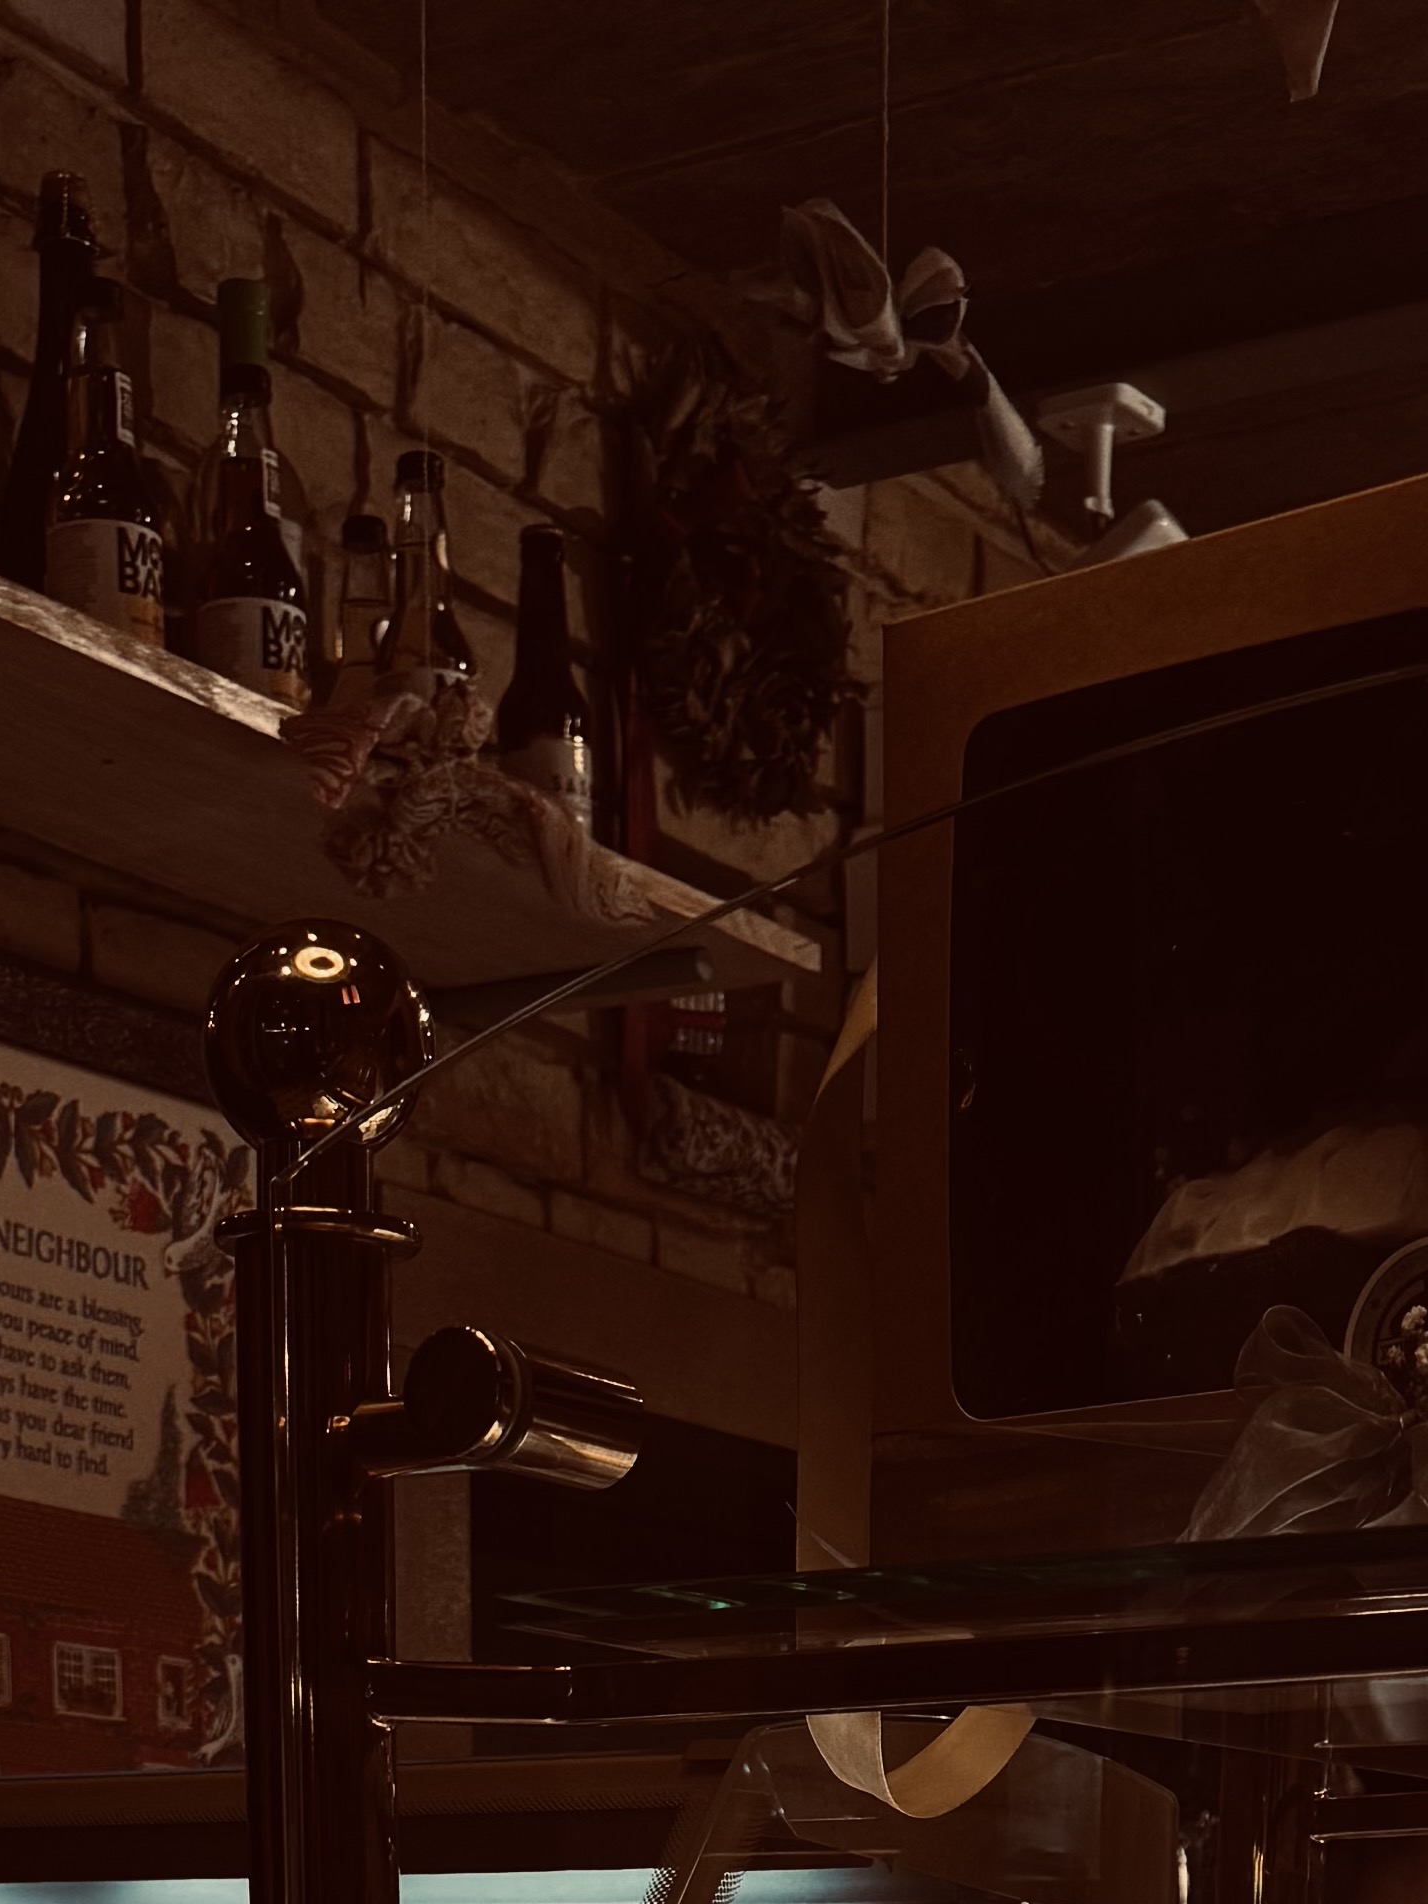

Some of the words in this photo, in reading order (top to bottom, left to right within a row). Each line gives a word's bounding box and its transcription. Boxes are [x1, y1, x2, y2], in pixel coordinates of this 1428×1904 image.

[39, 1291, 63, 1312] are
[68, 1299, 77, 1316] a
[28, 1319, 74, 1346] peace
[78, 1329, 96, 1354] of
[40, 1352, 56, 1372] to
[60, 1356, 86, 1380] ask
[21, 1374, 58, 1404] have
[63, 1386, 89, 1411] the
[15, 1410, 47, 1434] you
[53, 1413, 86, 1442] dear
[90, 1421, 134, 1450] friend
[15, 1435, 52, 1466] hard
[56, 1451, 72, 1470] to
